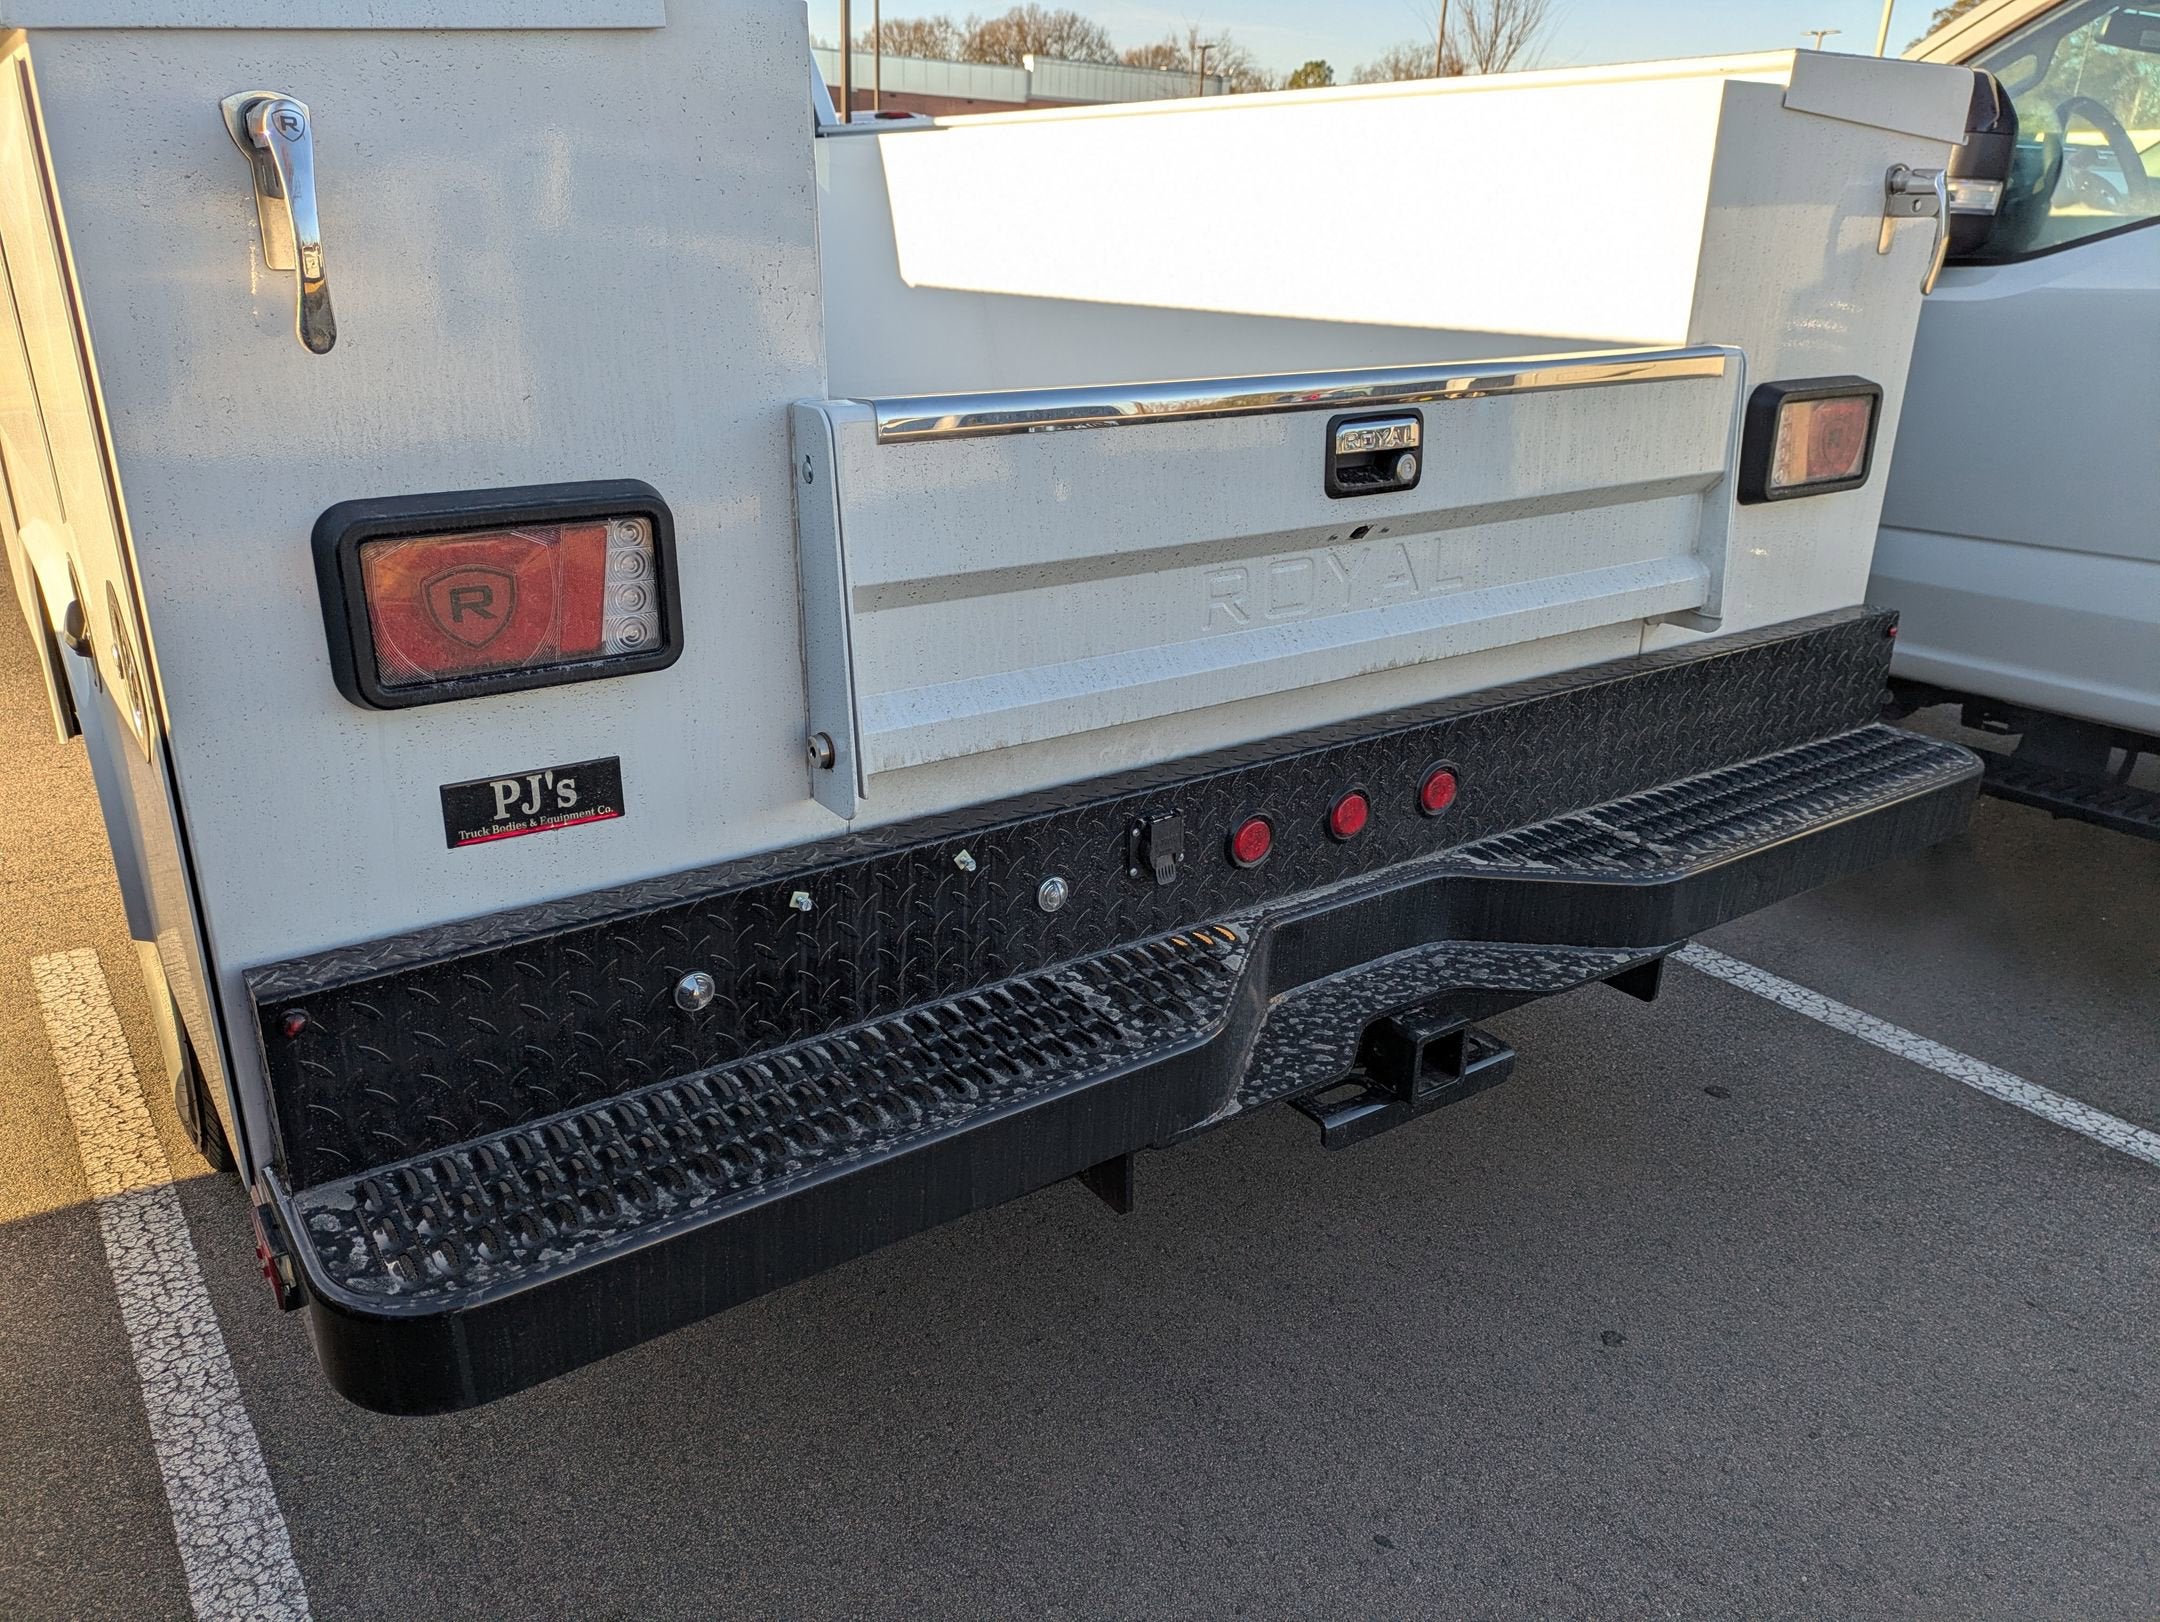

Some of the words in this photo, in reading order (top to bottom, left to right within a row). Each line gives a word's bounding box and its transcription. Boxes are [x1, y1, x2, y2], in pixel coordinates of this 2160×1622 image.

[280, 114, 299, 132] R
[1345, 426, 1415, 450] ROYAL
[1202, 537, 1463, 631] ROYAL
[449, 584, 498, 623] R
[490, 770, 578, 820] PJ's
[458, 826, 491, 840] Truck
[492, 821, 528, 835] Bodies
[529, 817, 538, 827] &
[540, 807, 595, 828] Equipment
[597, 804, 614, 815] Co.
